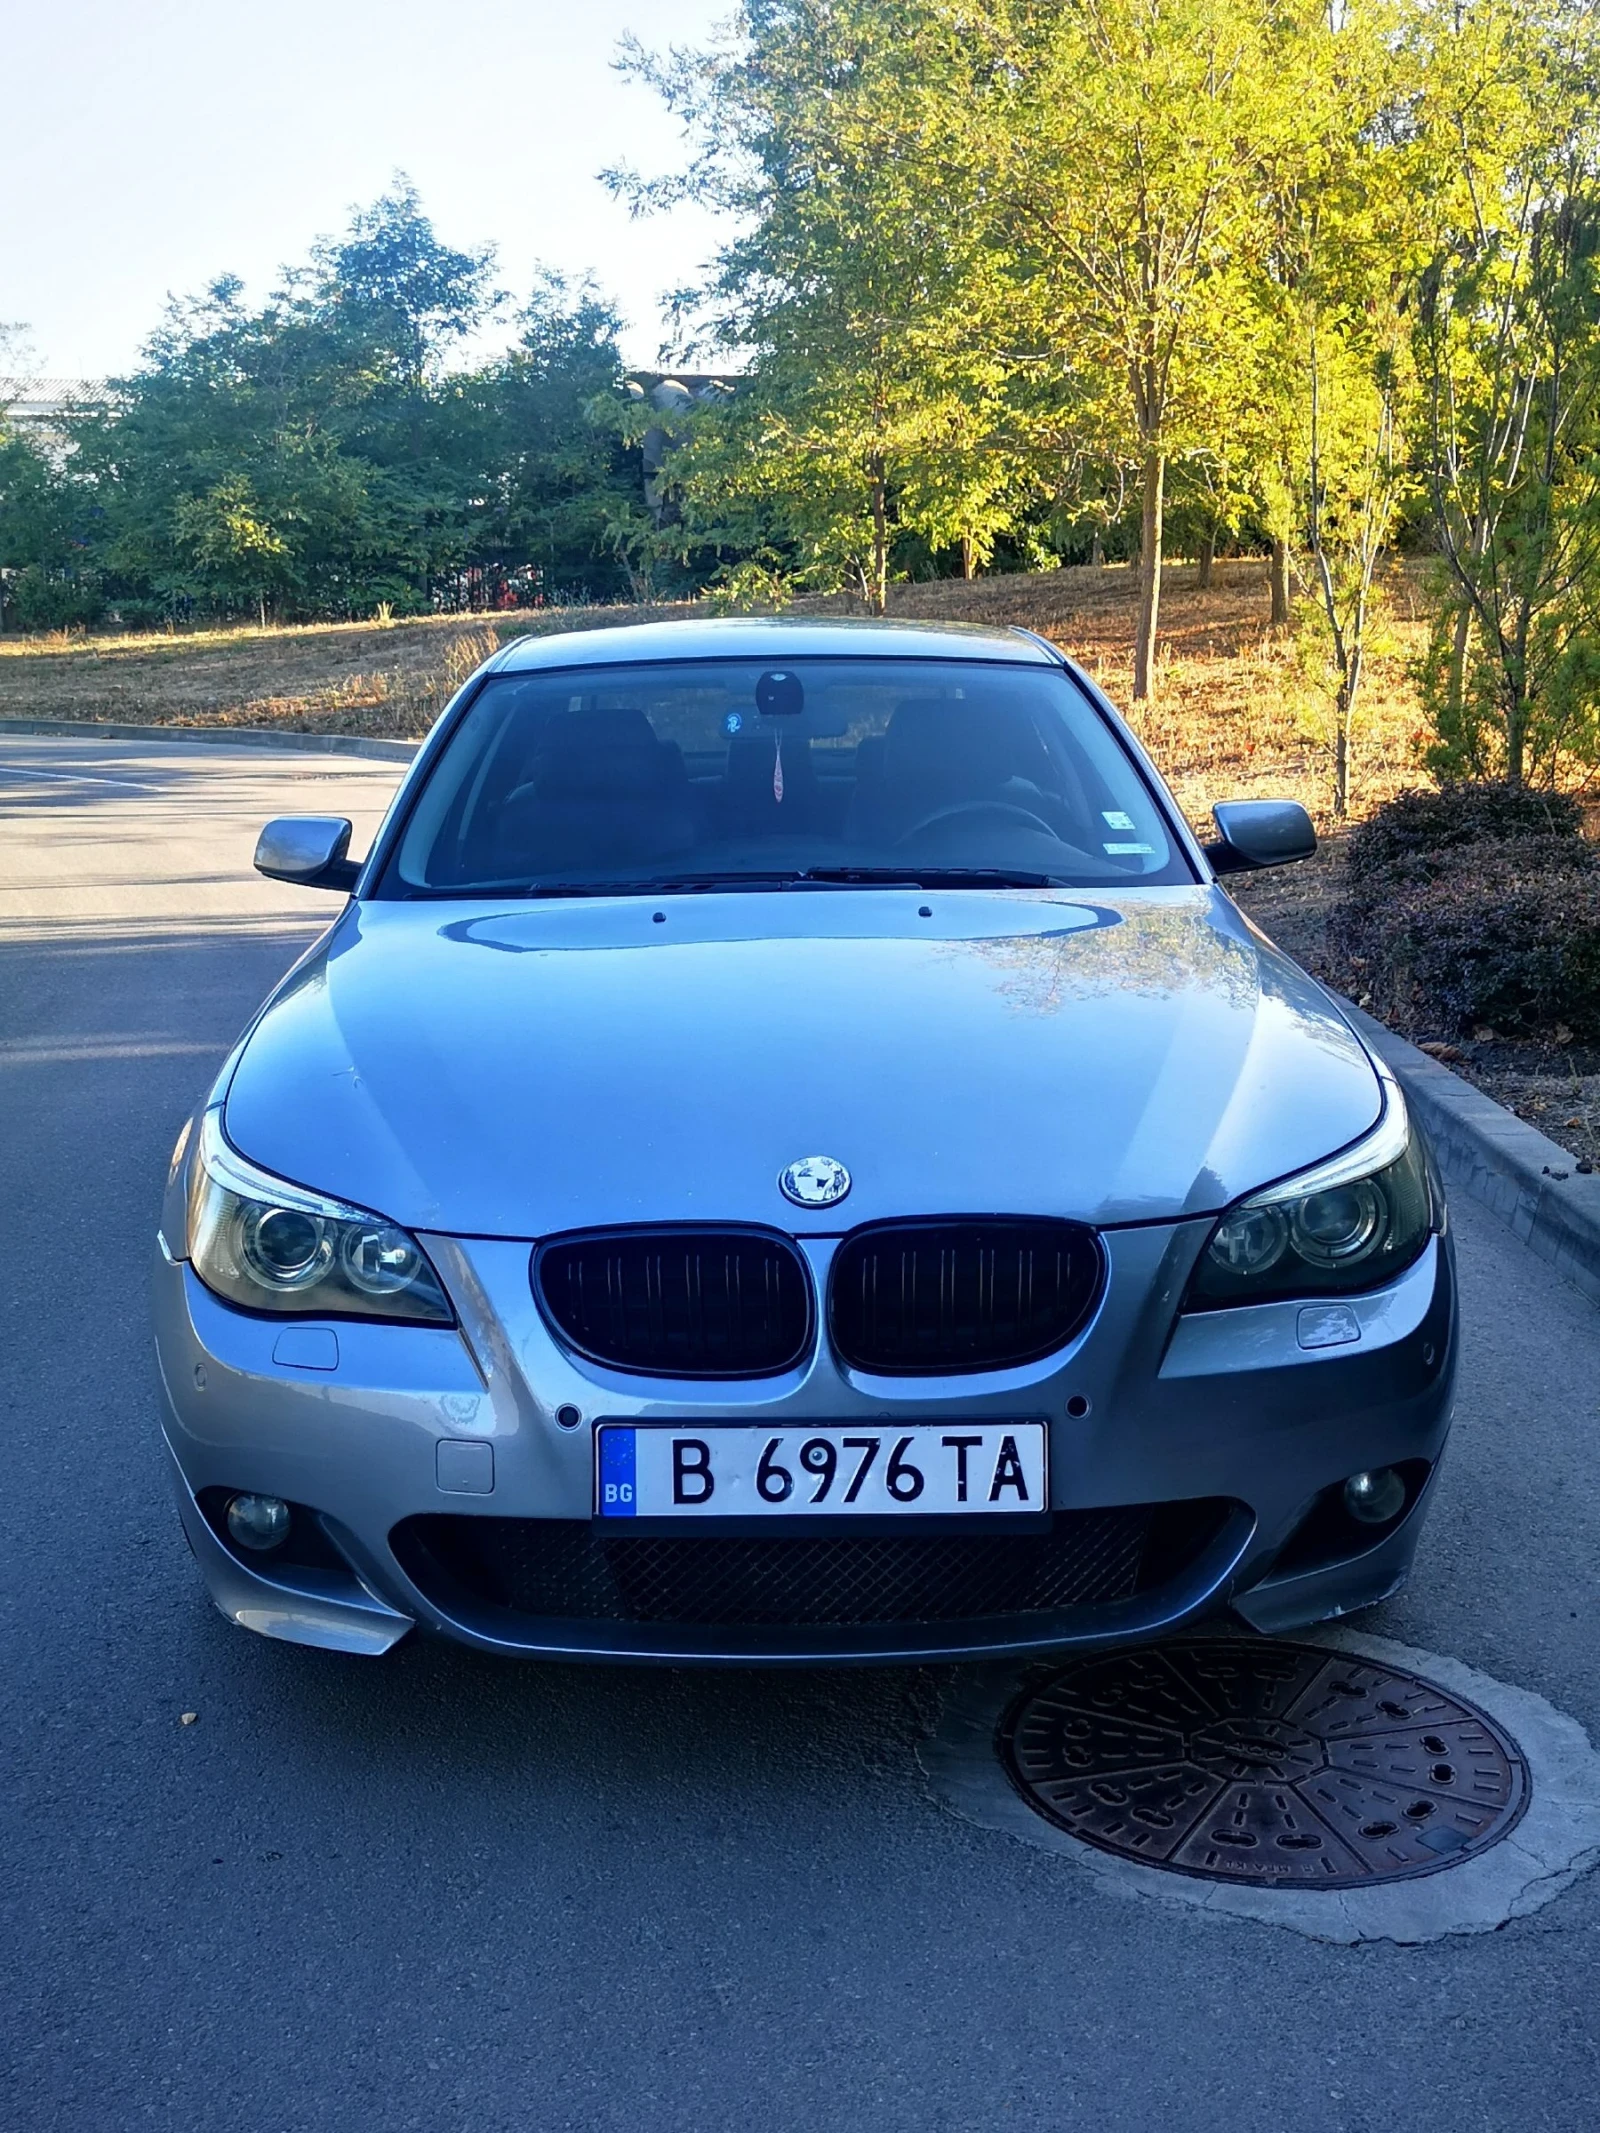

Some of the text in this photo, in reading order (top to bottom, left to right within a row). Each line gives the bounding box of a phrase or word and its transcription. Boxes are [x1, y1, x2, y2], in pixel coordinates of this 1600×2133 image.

[672, 1435, 1030, 1505] B 6976 TA
[604, 1483, 634, 1503] BG
